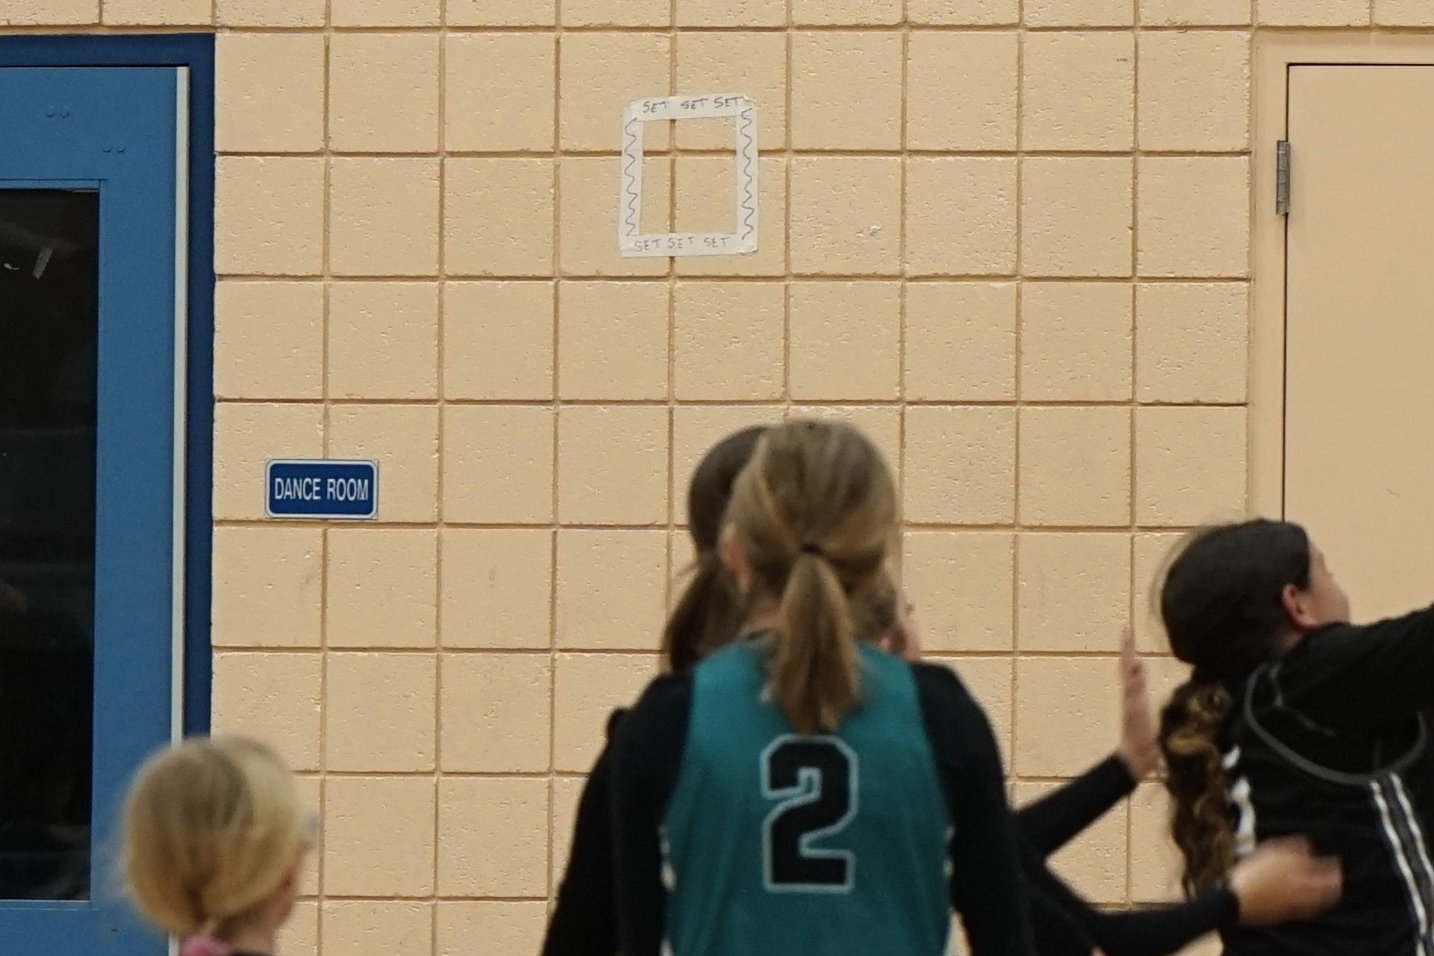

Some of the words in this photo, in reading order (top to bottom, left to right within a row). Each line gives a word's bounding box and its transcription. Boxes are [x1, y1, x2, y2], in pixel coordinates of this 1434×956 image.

[642, 101, 667, 113] SET
[681, 98, 708, 109] SET
[714, 96, 744, 108] SET
[635, 238, 660, 251] SET
[668, 237, 694, 249] SET
[704, 237, 730, 248] SET
[275, 478, 321, 500] DANCE
[327, 478, 368, 501] ROOM
[760, 734, 859, 894] 2
